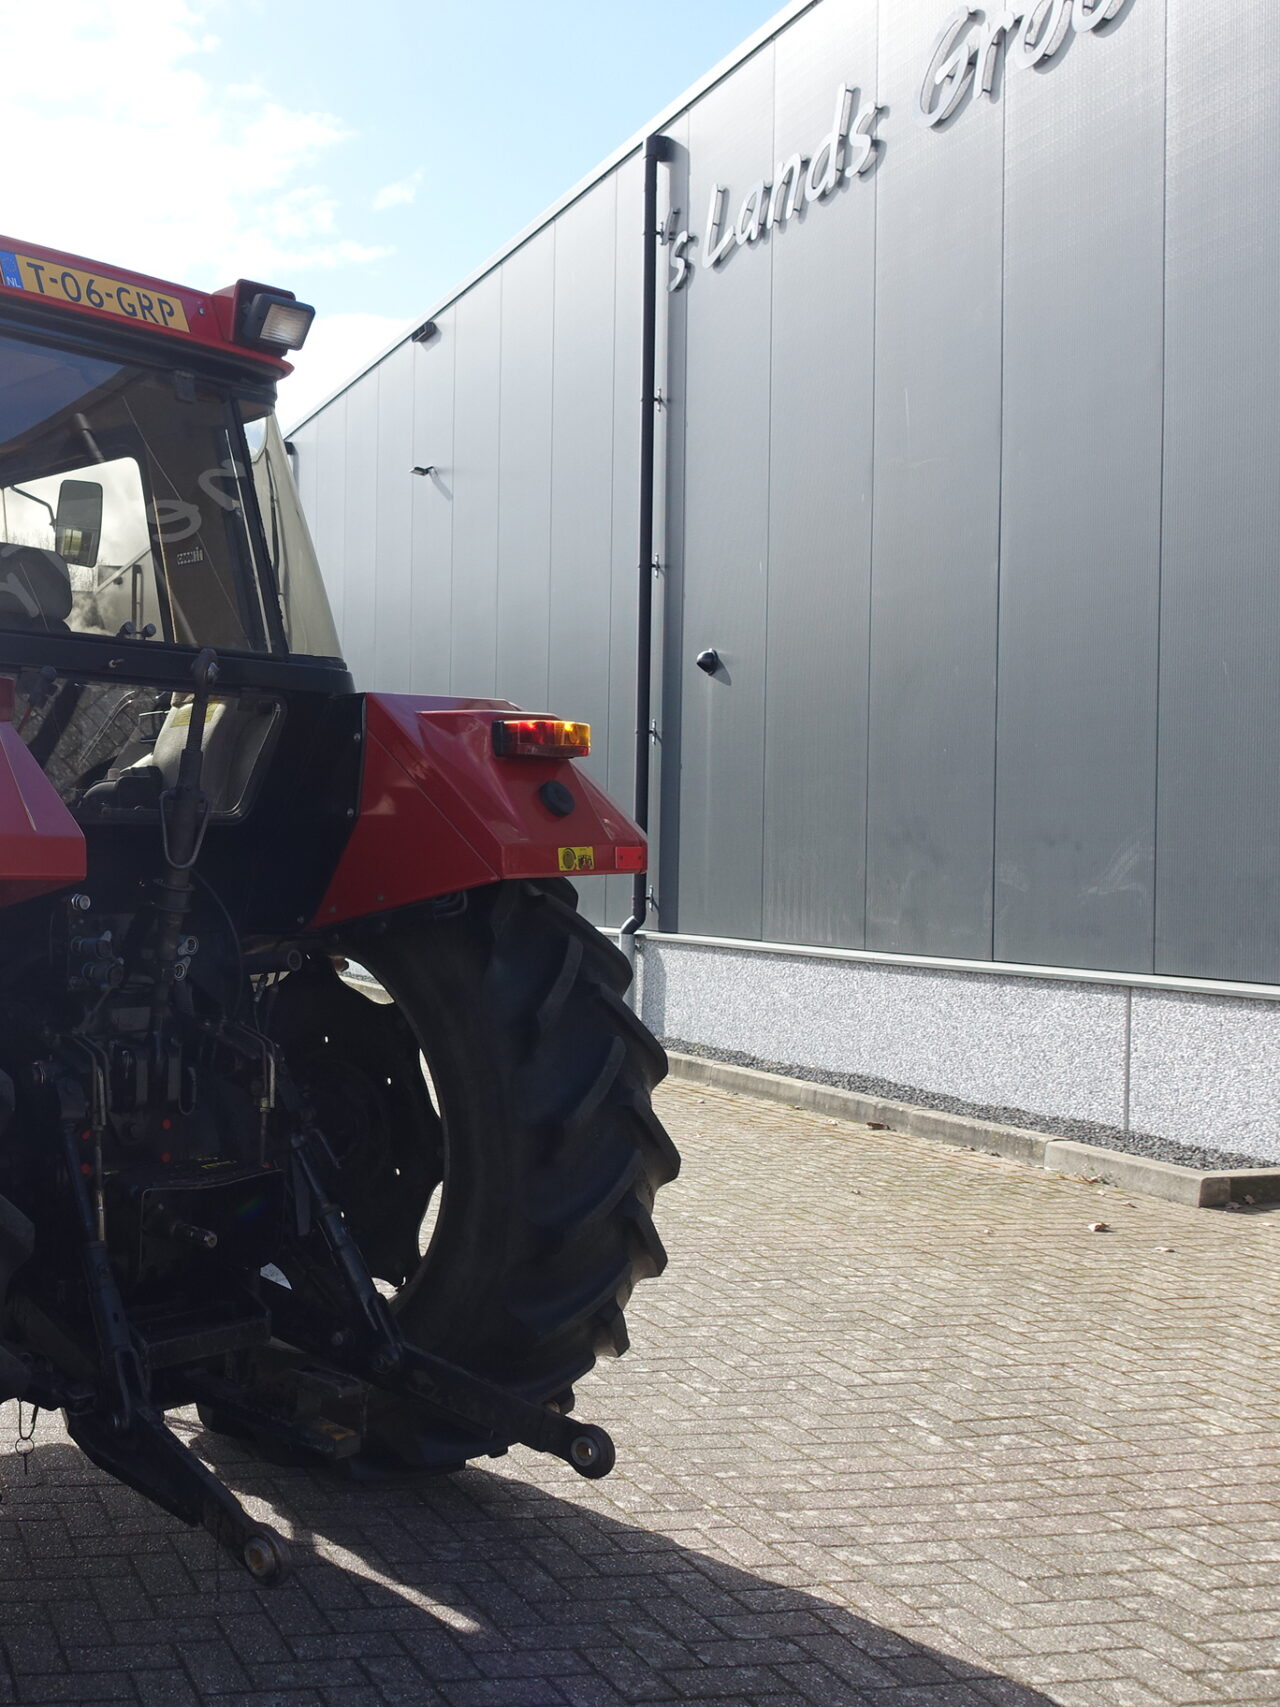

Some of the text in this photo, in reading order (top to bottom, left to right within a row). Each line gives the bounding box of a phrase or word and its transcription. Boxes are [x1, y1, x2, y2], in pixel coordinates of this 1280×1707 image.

[702, 82, 878, 269] Lands
[6, 275, 22, 289] NL
[26, 261, 175, 327] T-06-GRP
